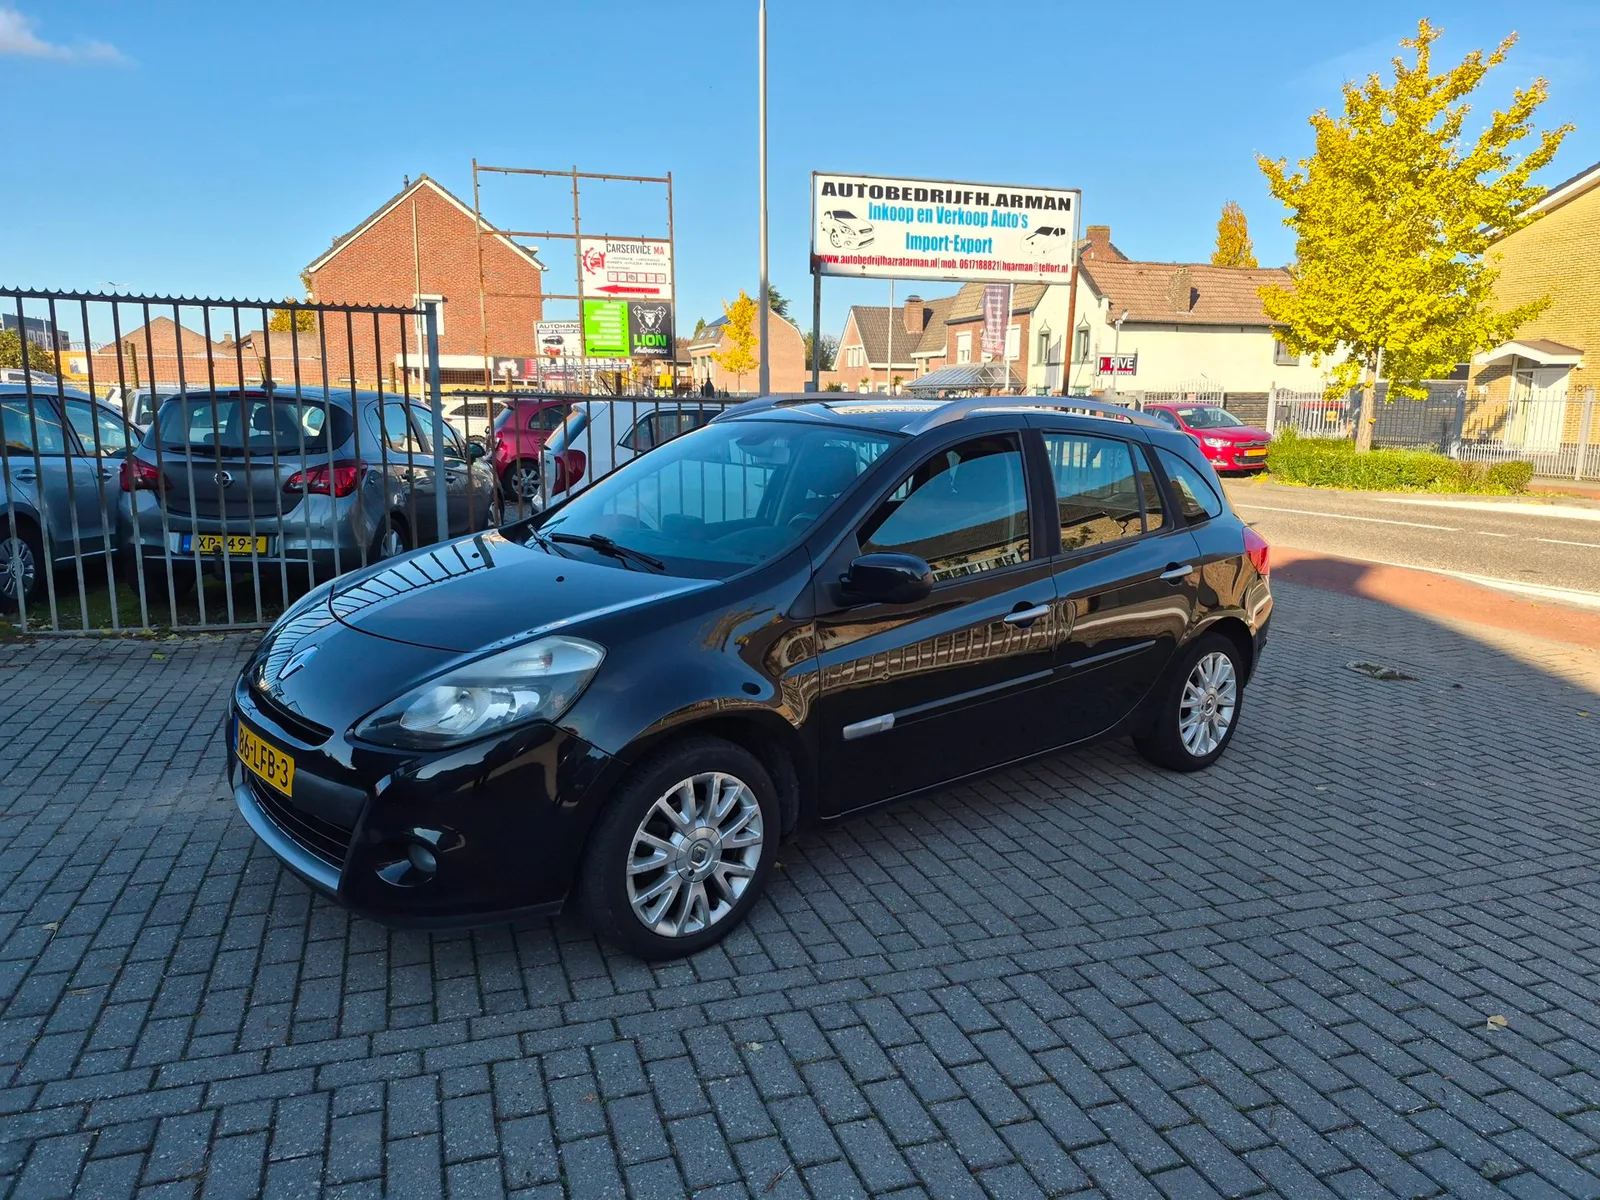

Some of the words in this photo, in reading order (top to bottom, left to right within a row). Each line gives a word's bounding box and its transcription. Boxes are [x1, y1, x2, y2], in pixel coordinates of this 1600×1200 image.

[868, 202, 914, 224] Inkoop
[917, 208, 933, 222] en
[936, 206, 988, 228] Verkoop
[991, 209, 1029, 229] Auto's
[606, 243, 651, 255] CARSERVICE
[654, 246, 665, 255] MA
[905, 232, 993, 254] Import-Export
[634, 334, 667, 346] LION
[239, 728, 288, 788] 86-LFB-3
